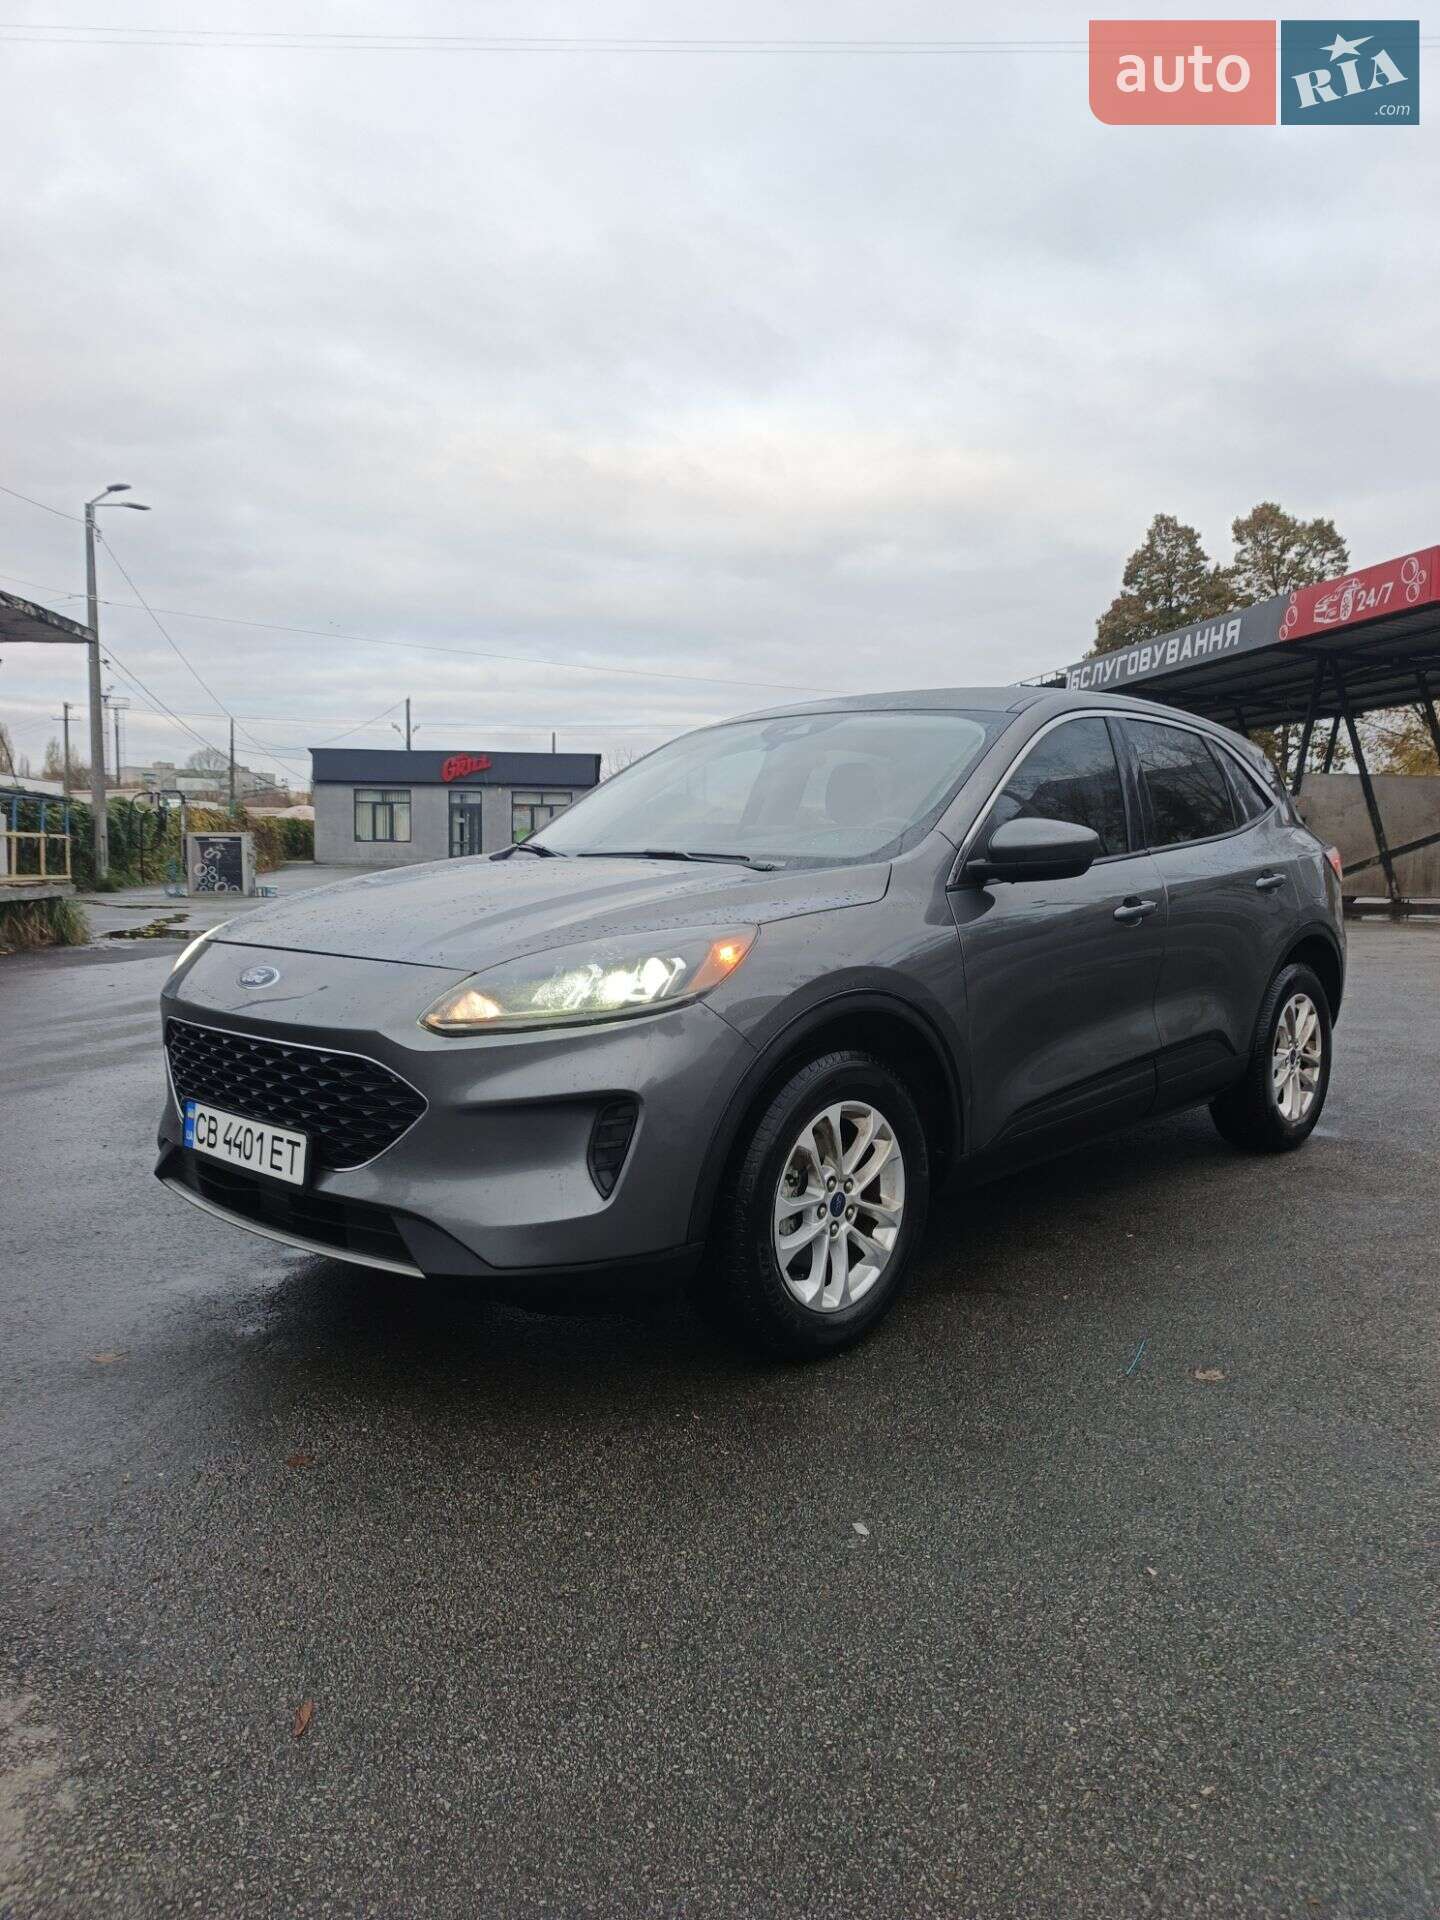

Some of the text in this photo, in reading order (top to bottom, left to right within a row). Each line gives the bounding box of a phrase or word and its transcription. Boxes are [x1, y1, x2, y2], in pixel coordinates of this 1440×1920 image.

[1356, 582, 1394, 612] 24/7
[196, 1112, 301, 1175] CB 4401 ET
